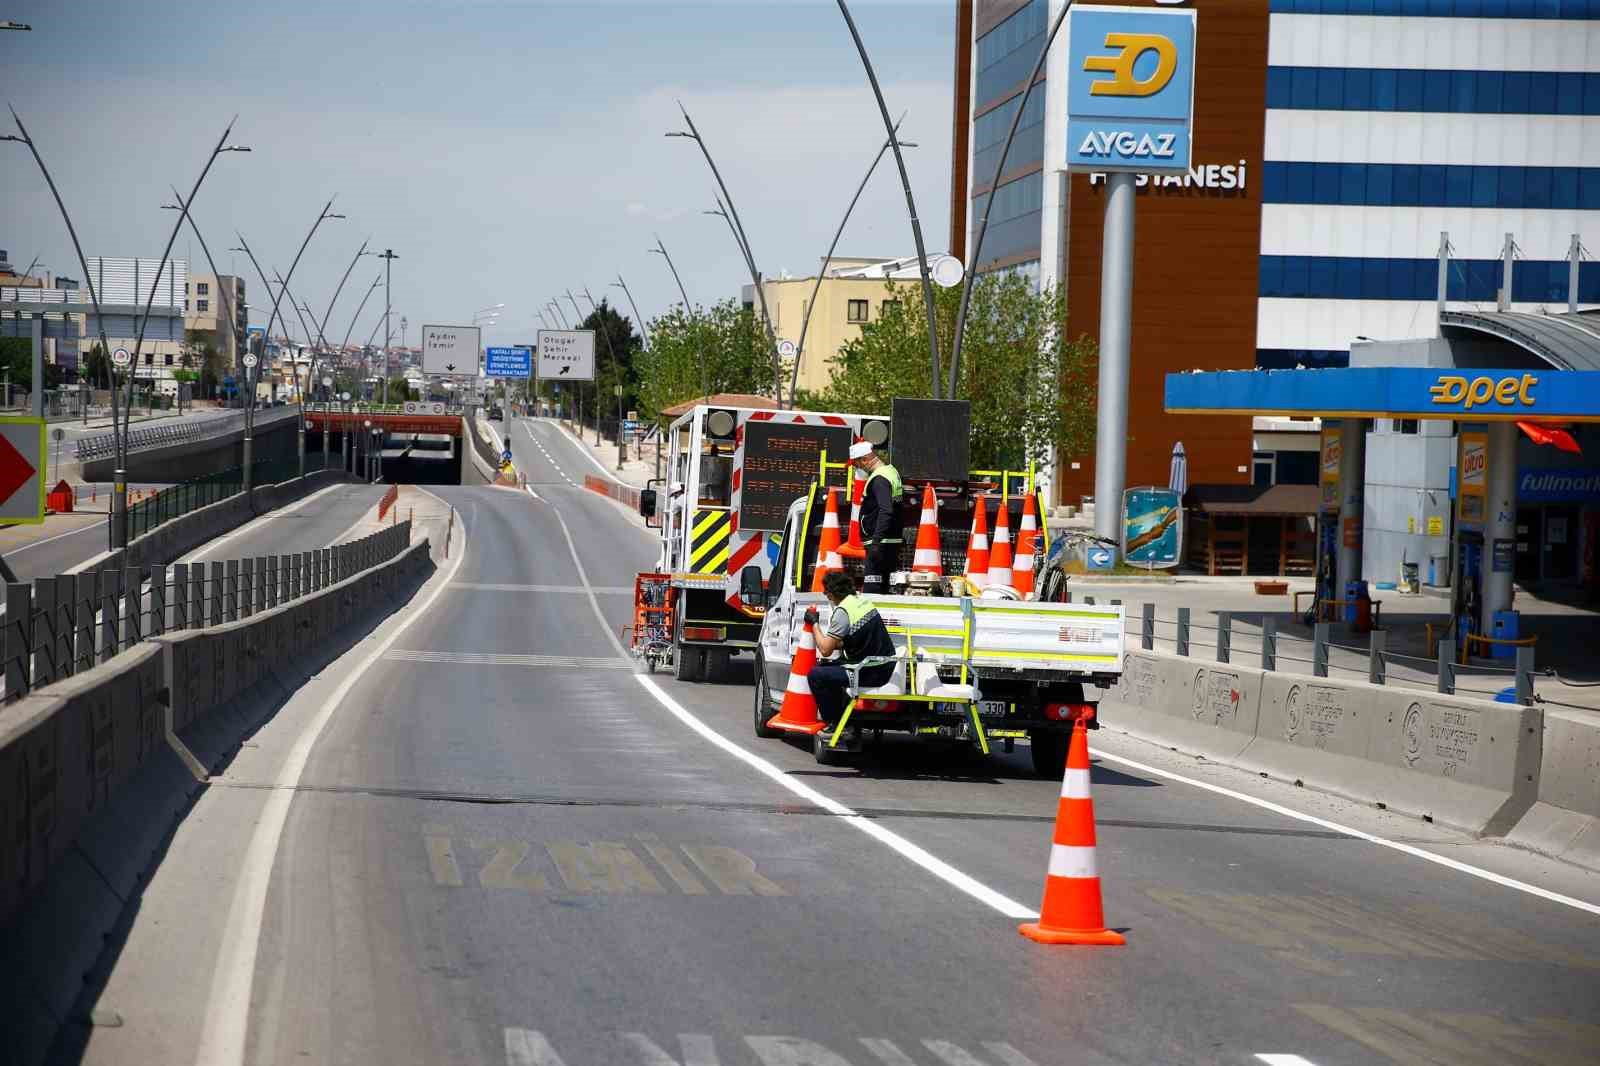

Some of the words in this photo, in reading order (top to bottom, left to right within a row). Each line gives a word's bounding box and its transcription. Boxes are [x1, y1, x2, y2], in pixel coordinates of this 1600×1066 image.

[1079, 130, 1176, 157] AYGAZ
[985, 702, 1004, 713] 330
[423, 824, 786, 897] İZMİR
